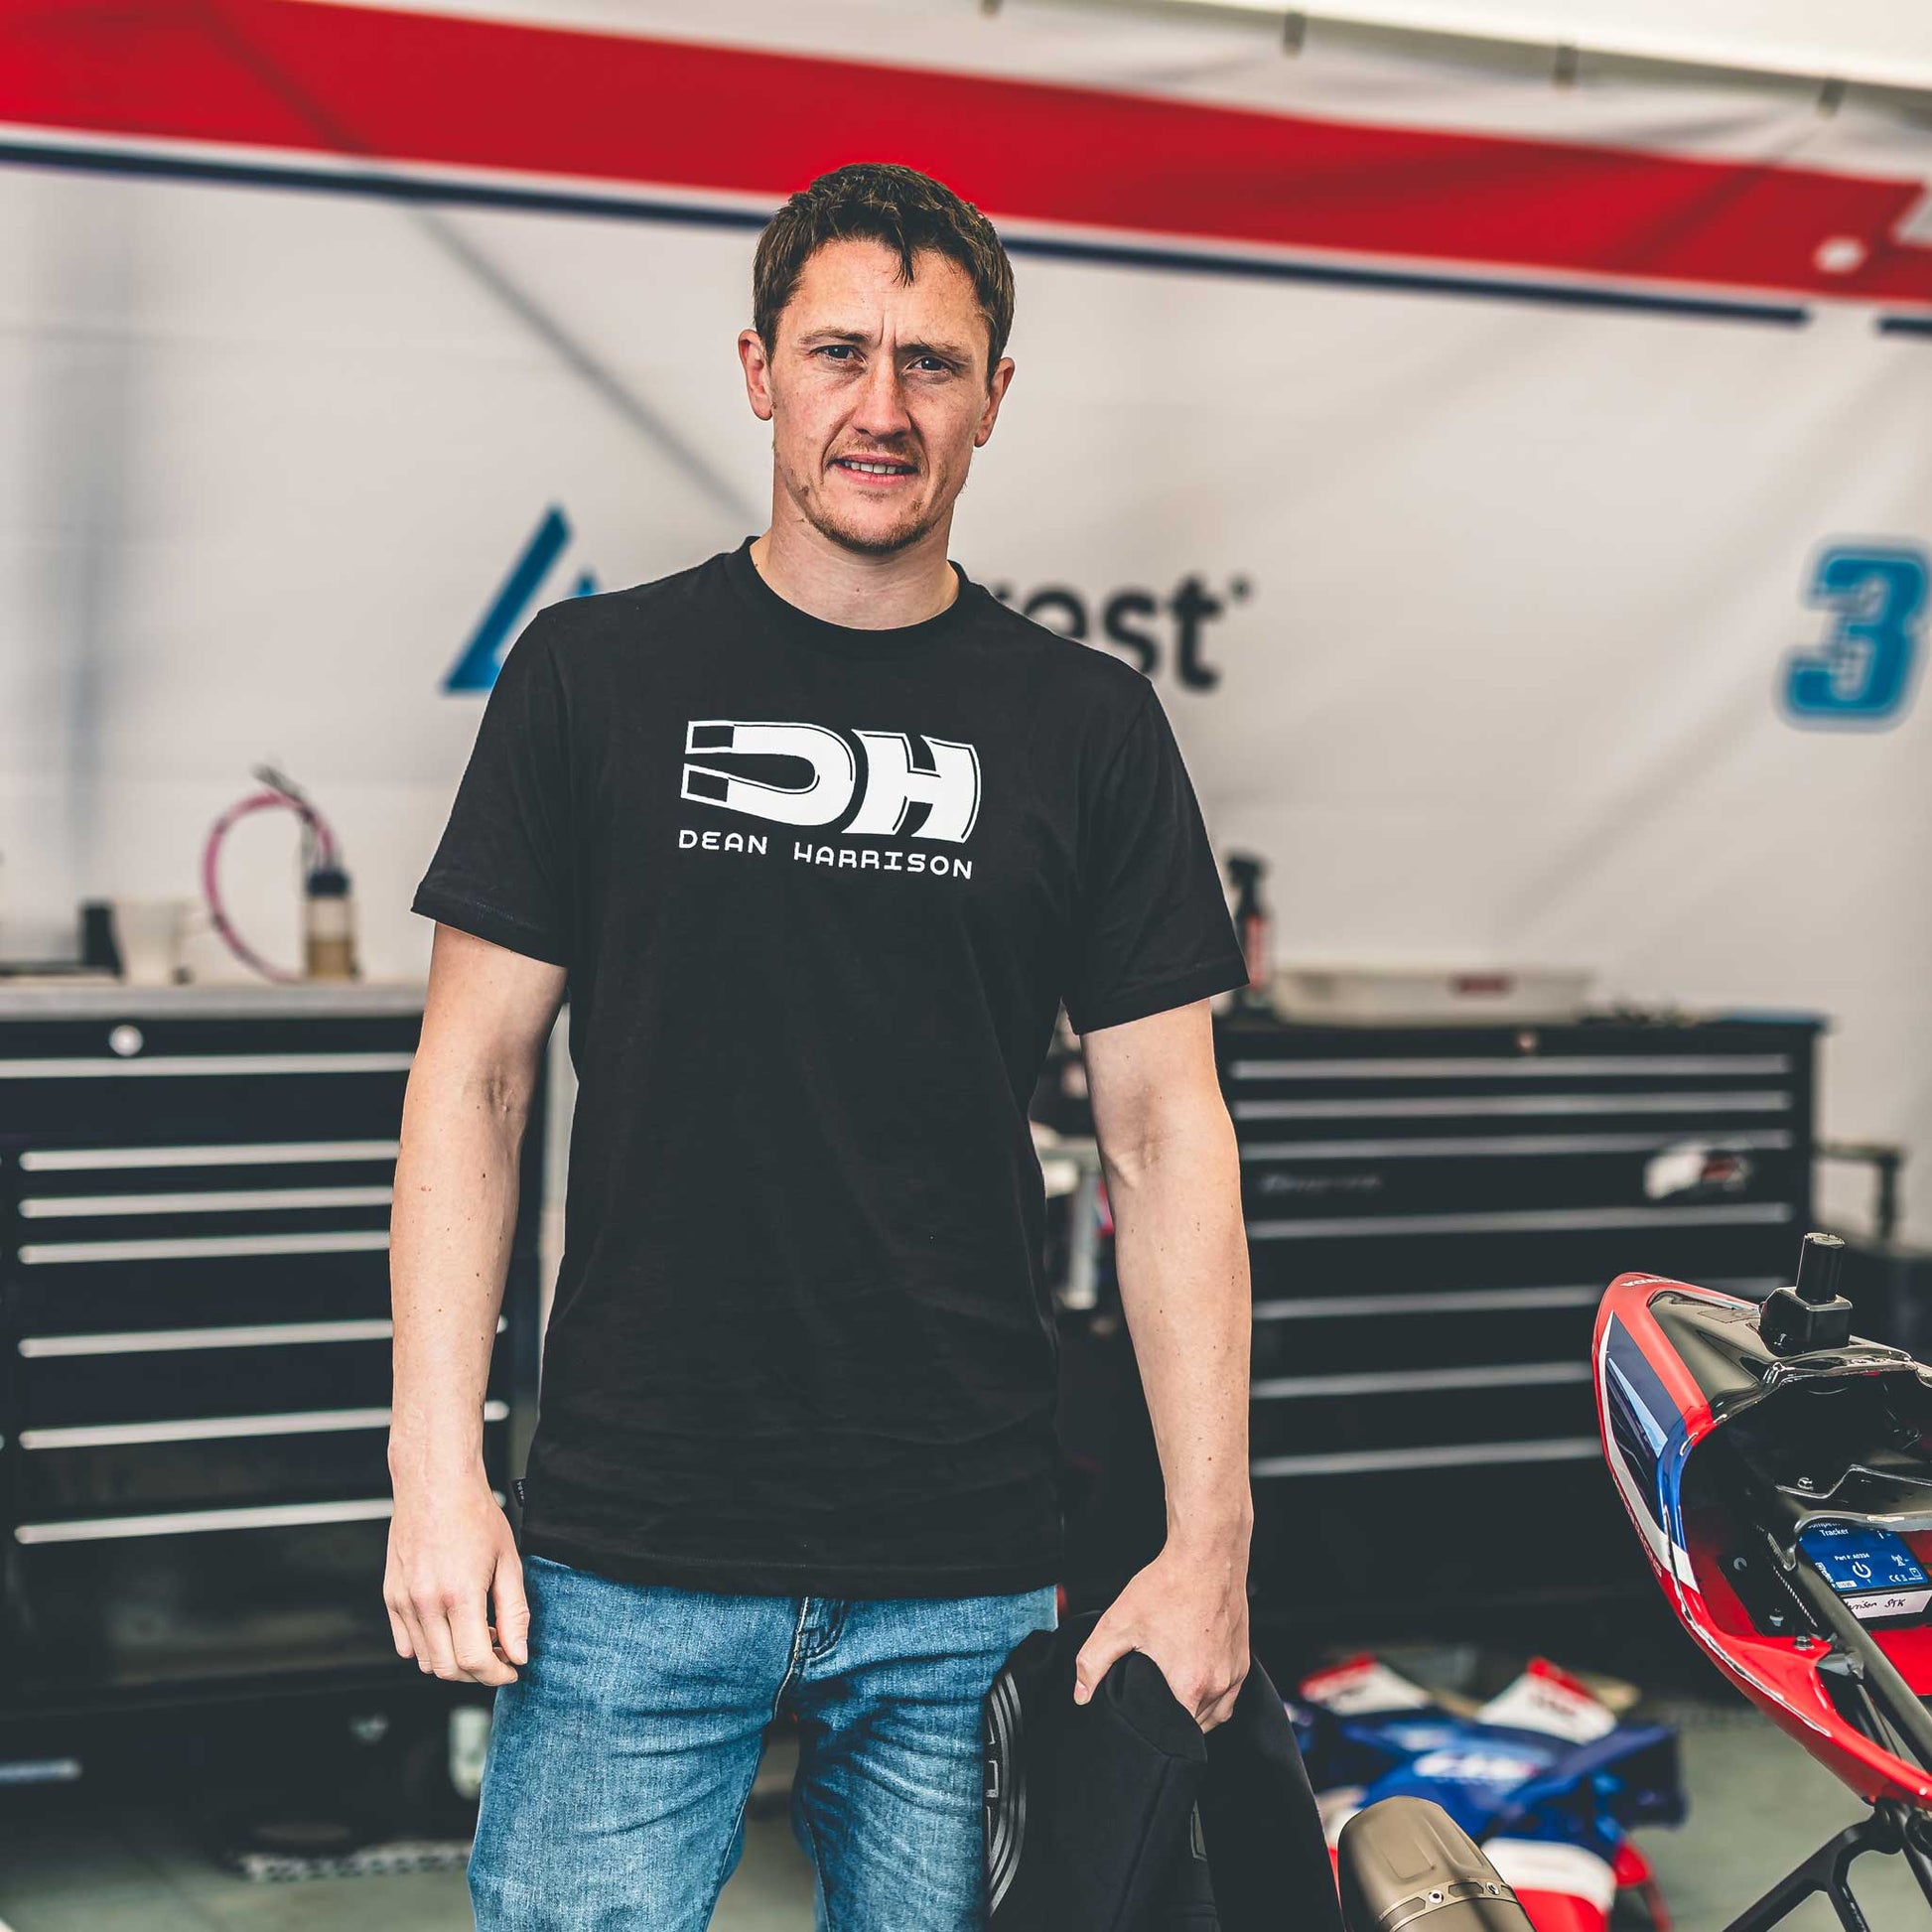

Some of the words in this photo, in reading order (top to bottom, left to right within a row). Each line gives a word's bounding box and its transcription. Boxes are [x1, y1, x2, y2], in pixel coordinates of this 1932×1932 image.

[681, 721, 981, 843] DH
[678, 830, 768, 855] DEAN
[793, 842, 973, 880] HARRISON
[1819, 1528, 1850, 1537] Tracker
[1884, 1598, 1906, 1608] STK
